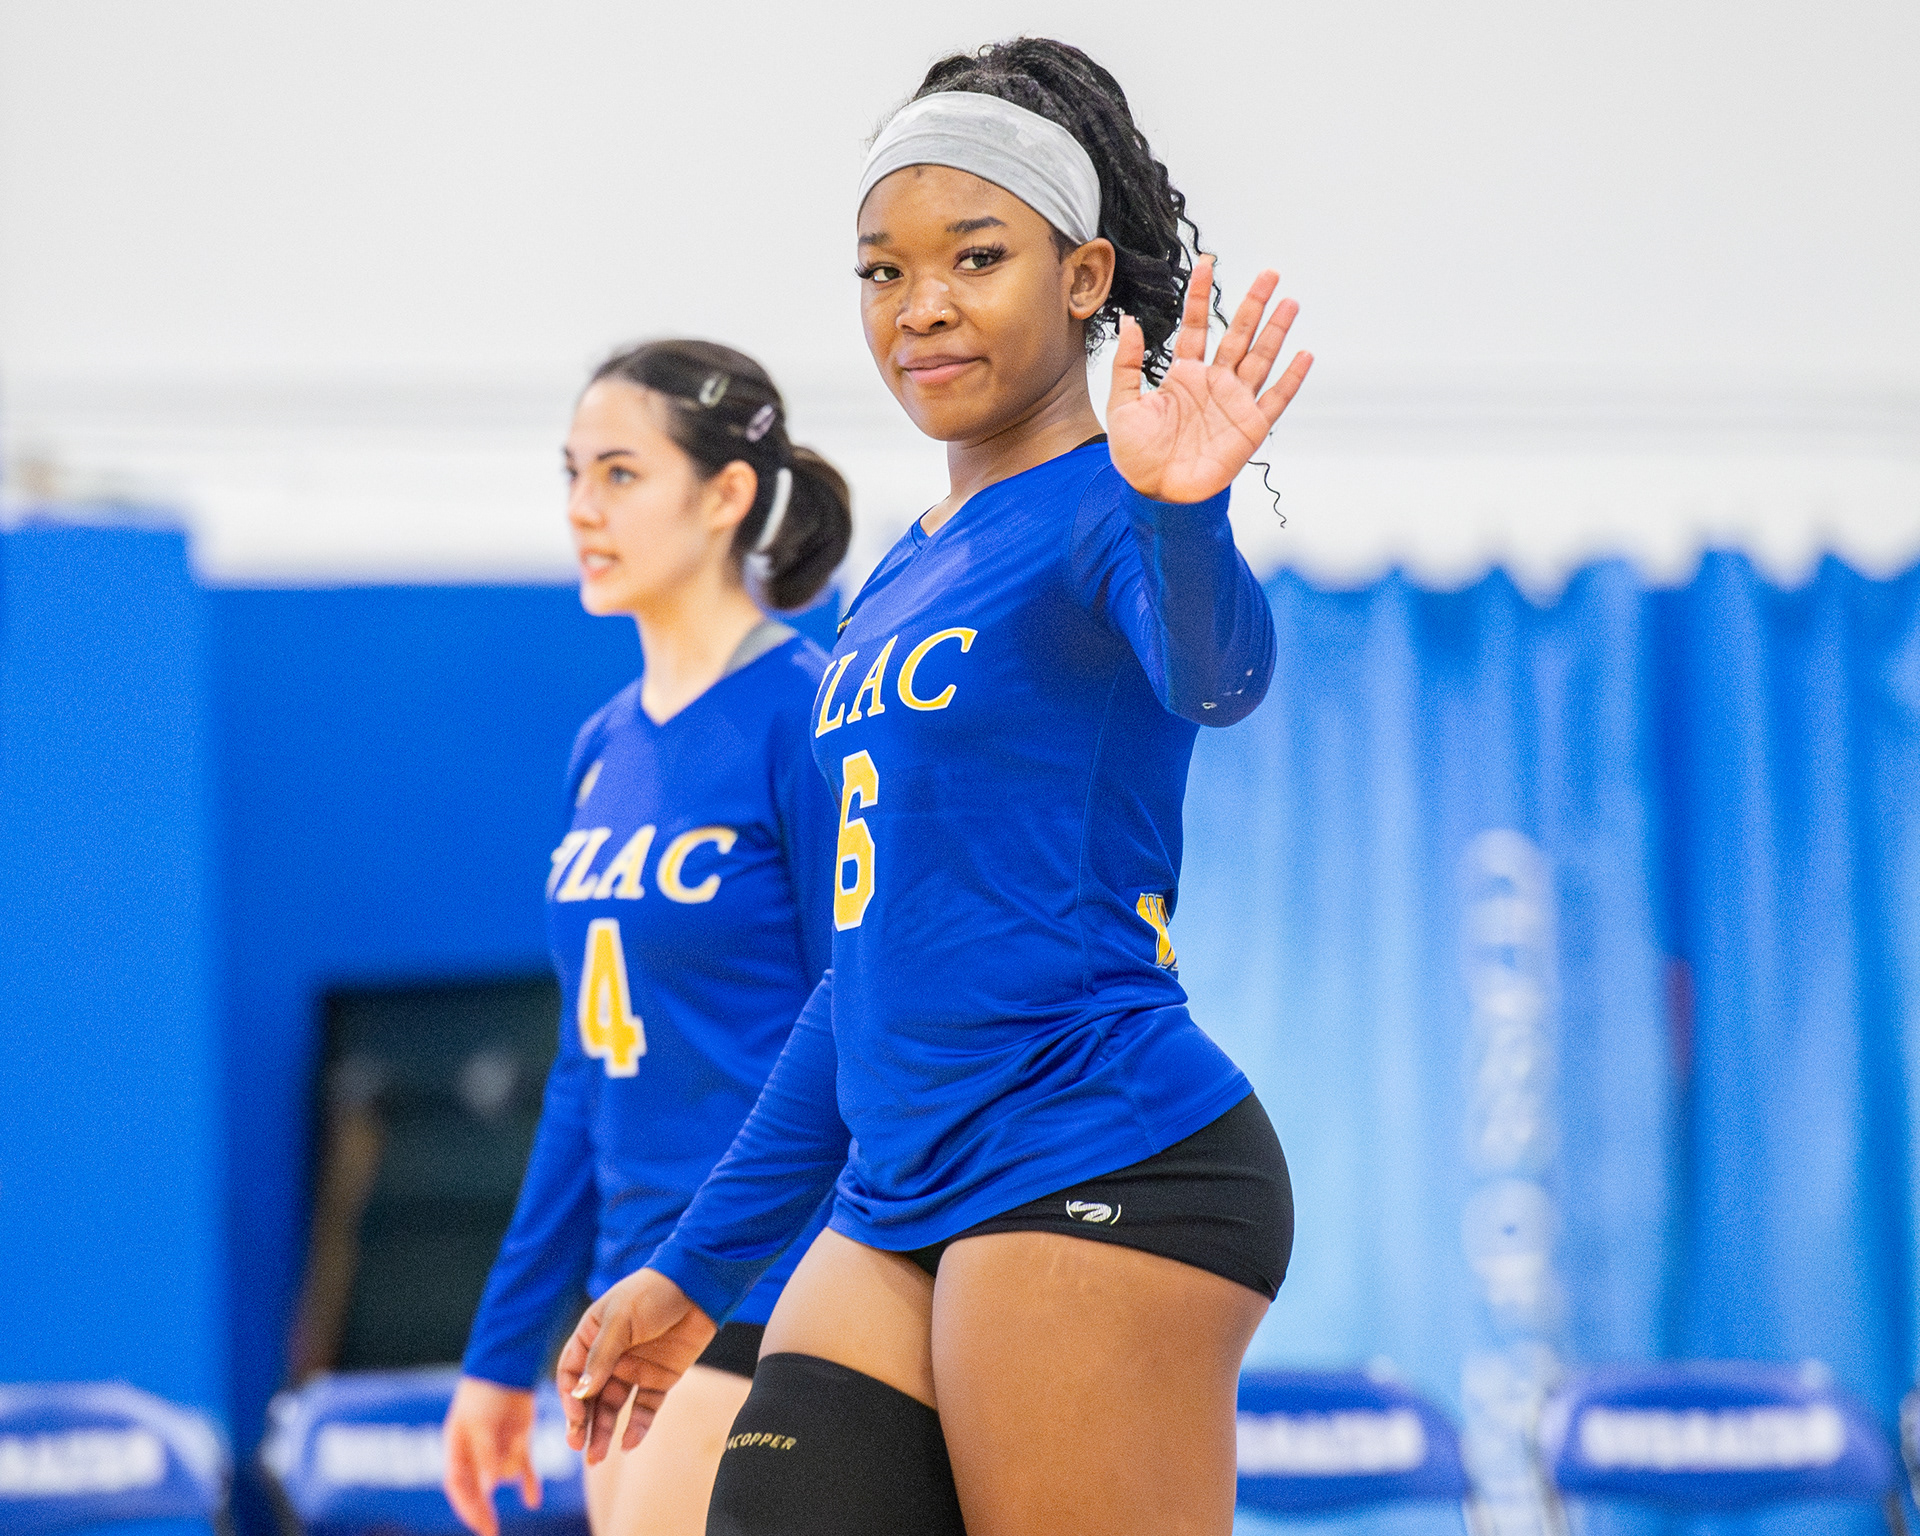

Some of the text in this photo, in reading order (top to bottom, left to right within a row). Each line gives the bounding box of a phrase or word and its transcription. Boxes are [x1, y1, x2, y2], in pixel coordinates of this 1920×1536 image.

[812, 627, 979, 739] LAC
[833, 749, 880, 932] 6
[577, 917, 648, 1079] 4
[727, 1432, 798, 1450] COPPER
